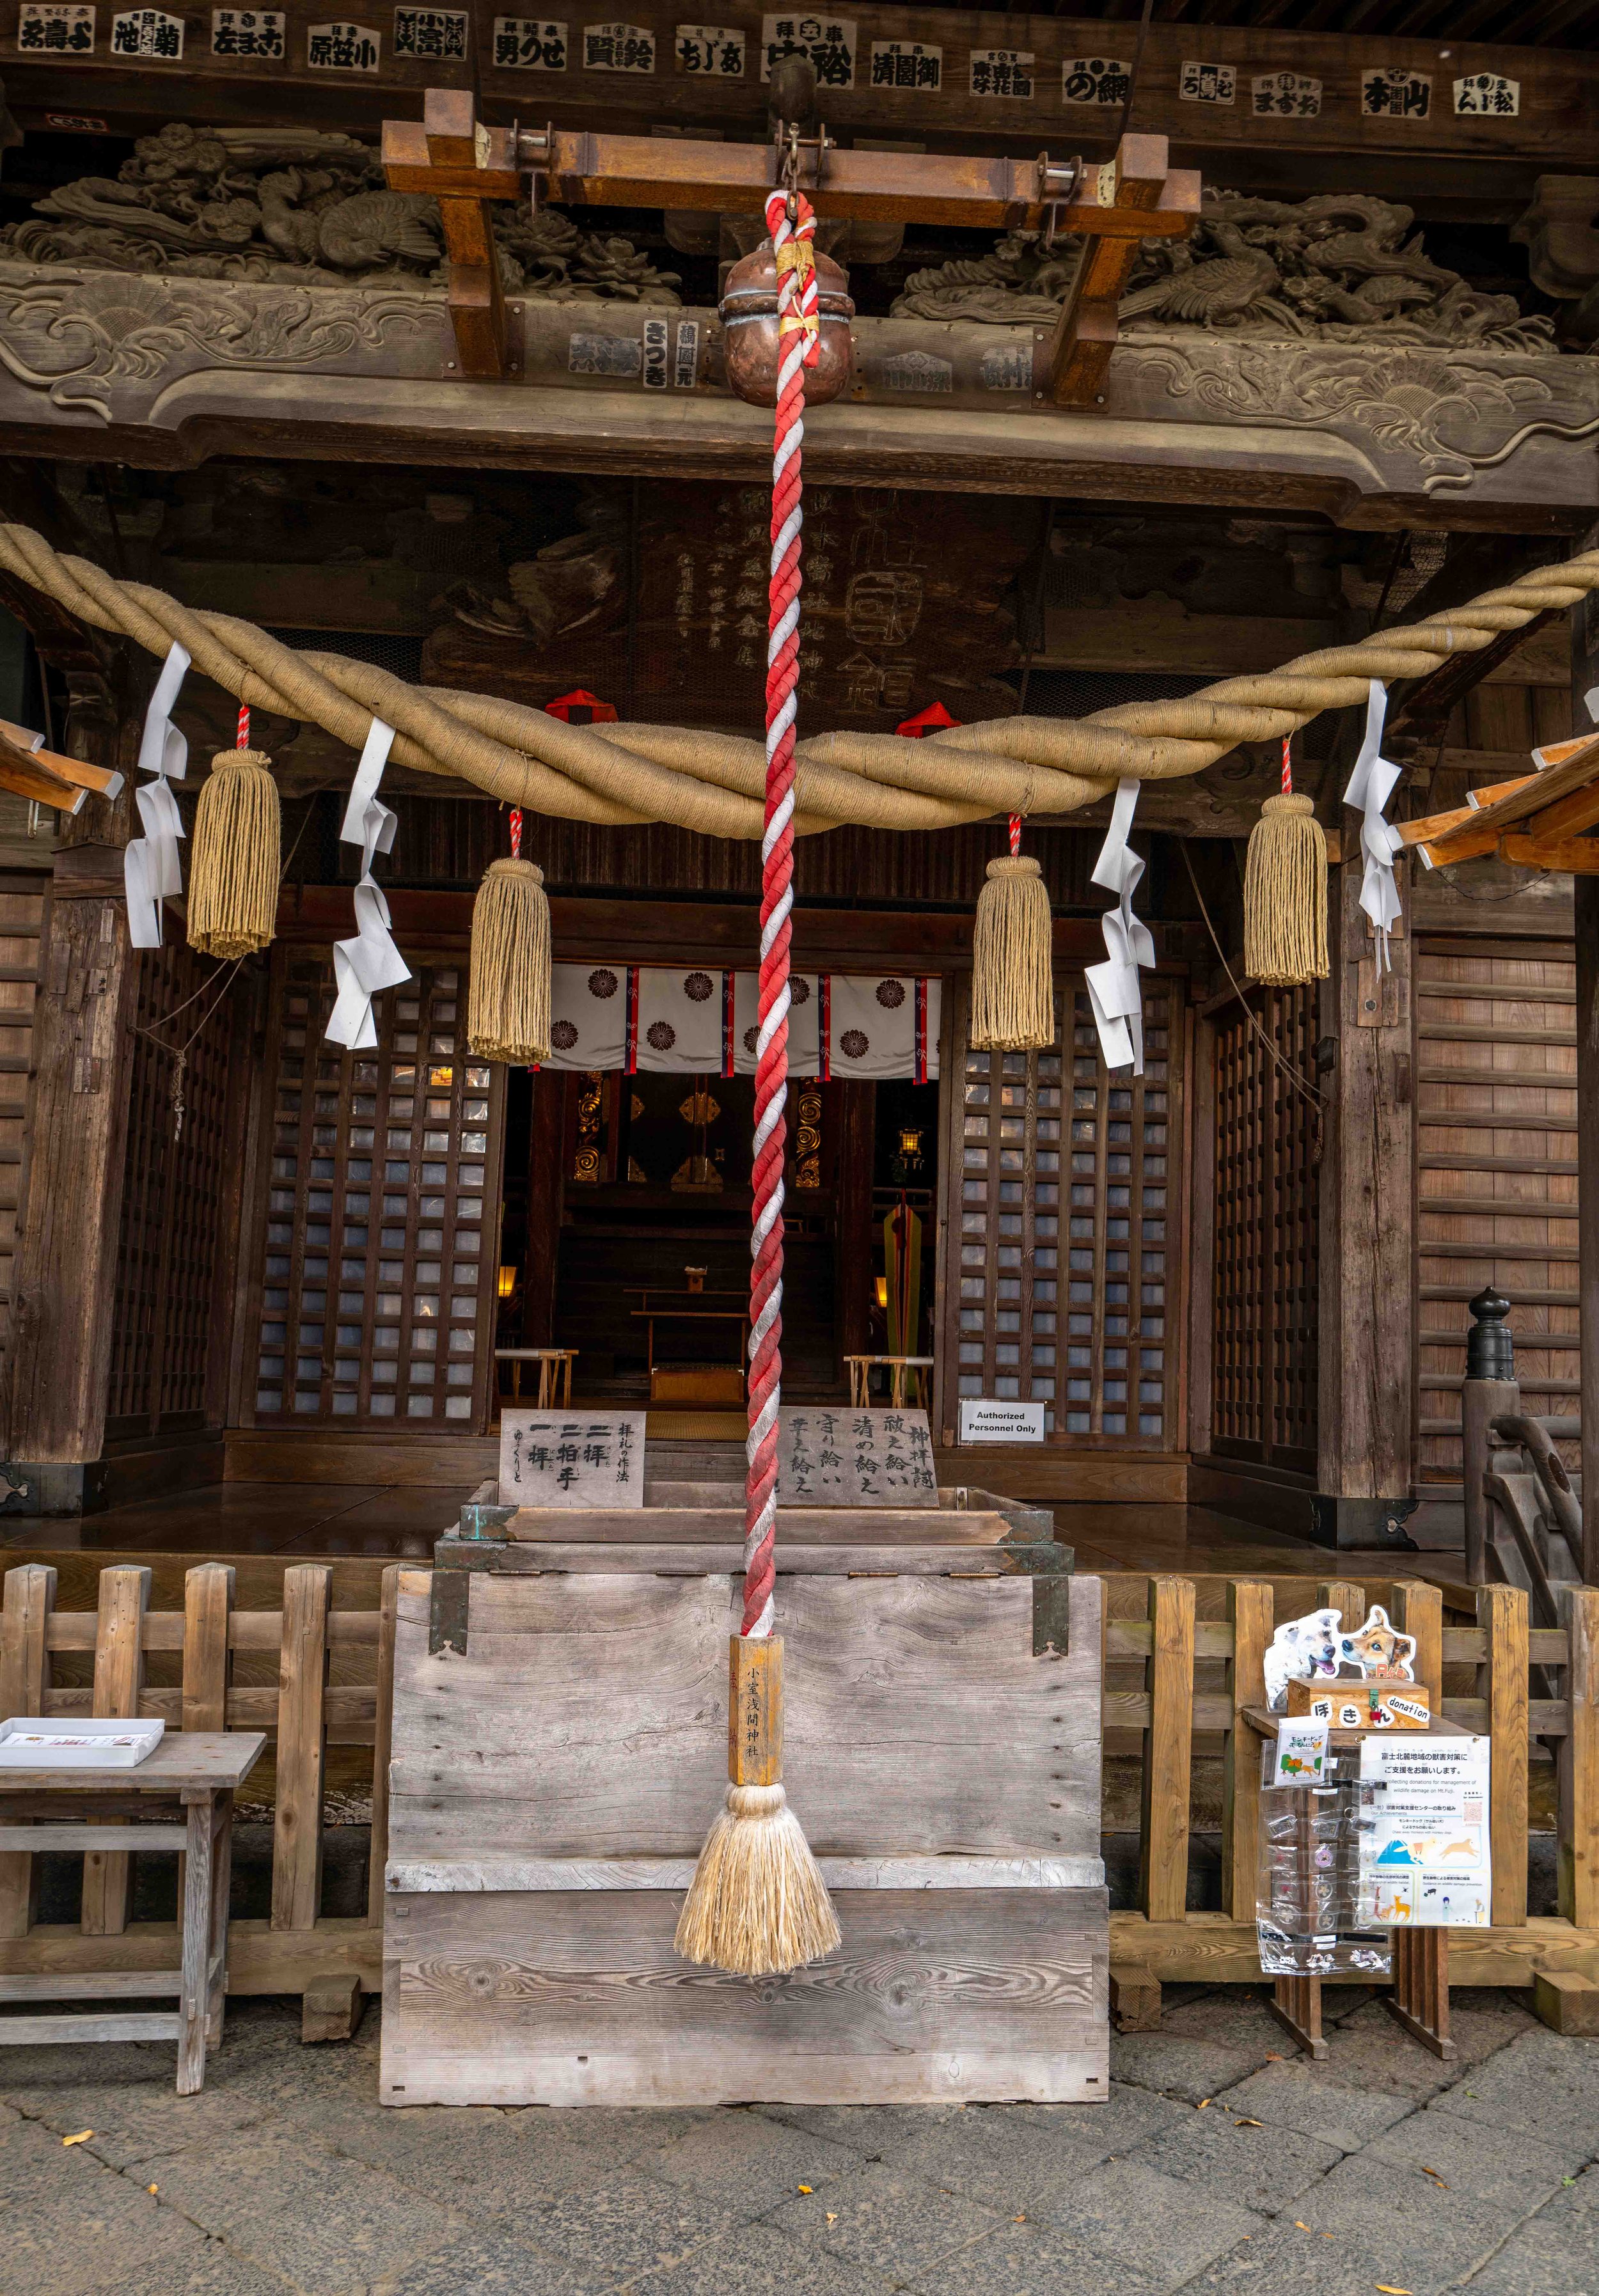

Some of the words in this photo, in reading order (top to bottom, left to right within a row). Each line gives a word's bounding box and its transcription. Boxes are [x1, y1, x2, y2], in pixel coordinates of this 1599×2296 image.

[310, 35, 376, 68] 小笠原
[646, 322, 666, 387] さつき
[969, 1424, 1014, 1432] Personnel
[1016, 1425, 1036, 1434] Only
[977, 1411, 1025, 1420] Authorized
[514, 1429, 523, 1483] ゆっくりと
[528, 1424, 555, 1471] 一拝
[556, 1424, 583, 1491] 二拍手
[583, 1424, 612, 1468] 二拝
[615, 1422, 635, 1483] 拝礼の作法
[851, 1415, 881, 1495] 清め給え
[746, 1667, 760, 1757] 小室浅間神社
[1389, 1698, 1428, 1718] donation
[1381, 1752, 1468, 1761] 富士北麓地域の獣害対策に
